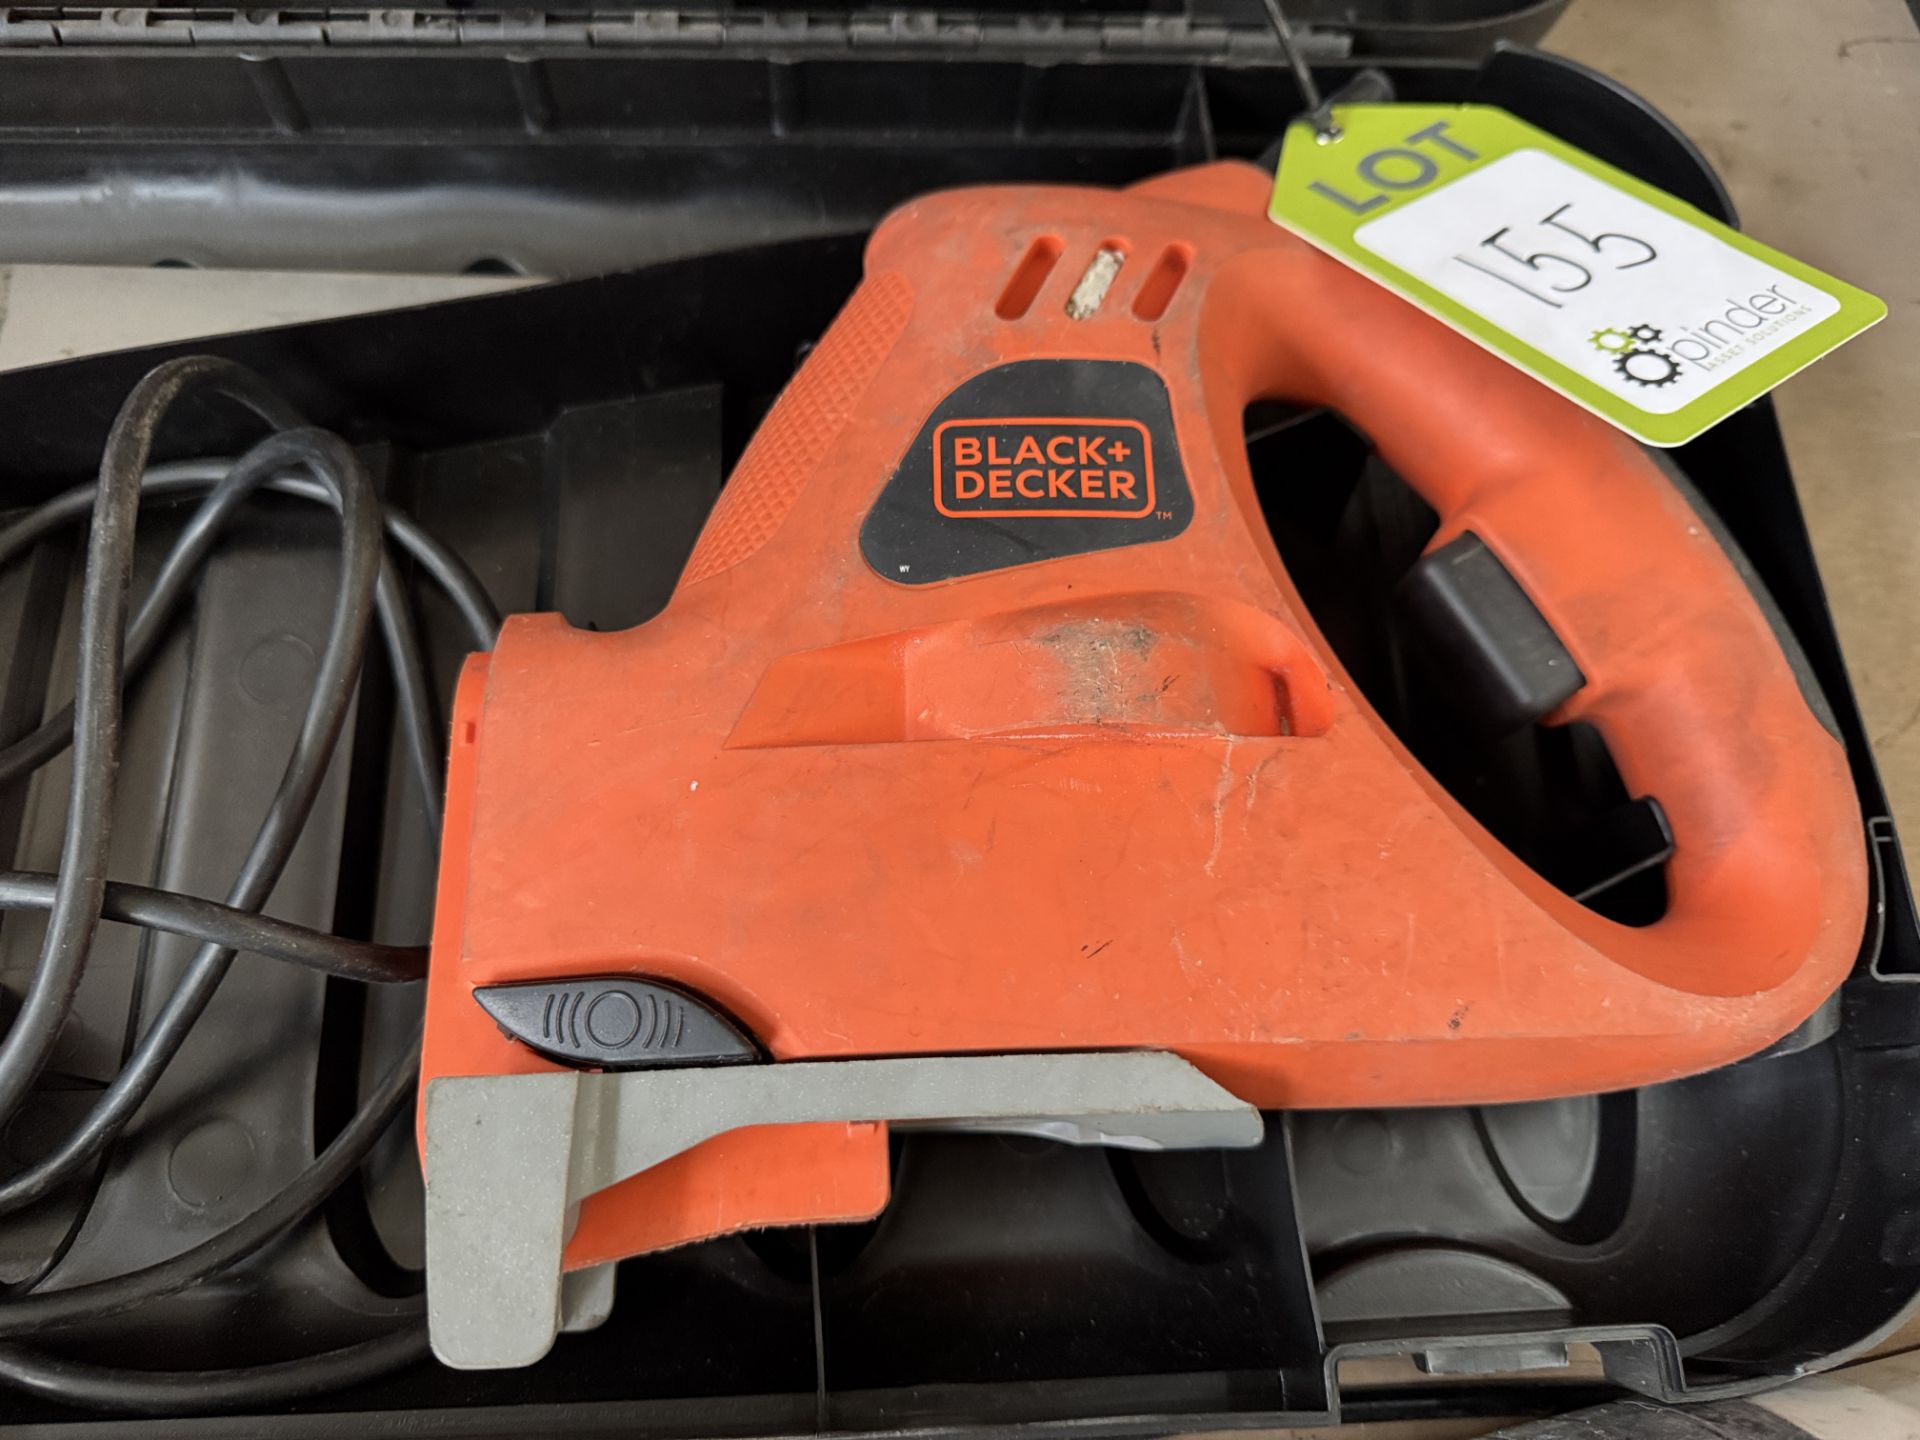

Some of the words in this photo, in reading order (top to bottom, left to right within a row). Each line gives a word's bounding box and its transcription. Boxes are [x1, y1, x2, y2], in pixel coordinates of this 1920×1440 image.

[1307, 121, 1479, 216] LOT
[1452, 202, 1658, 309] 155
[1666, 284, 1797, 372] pinder
[1745, 304, 1812, 346] SOLUTIONS
[954, 435, 1132, 466] BLACK+
[954, 469, 1138, 500] DECKER
